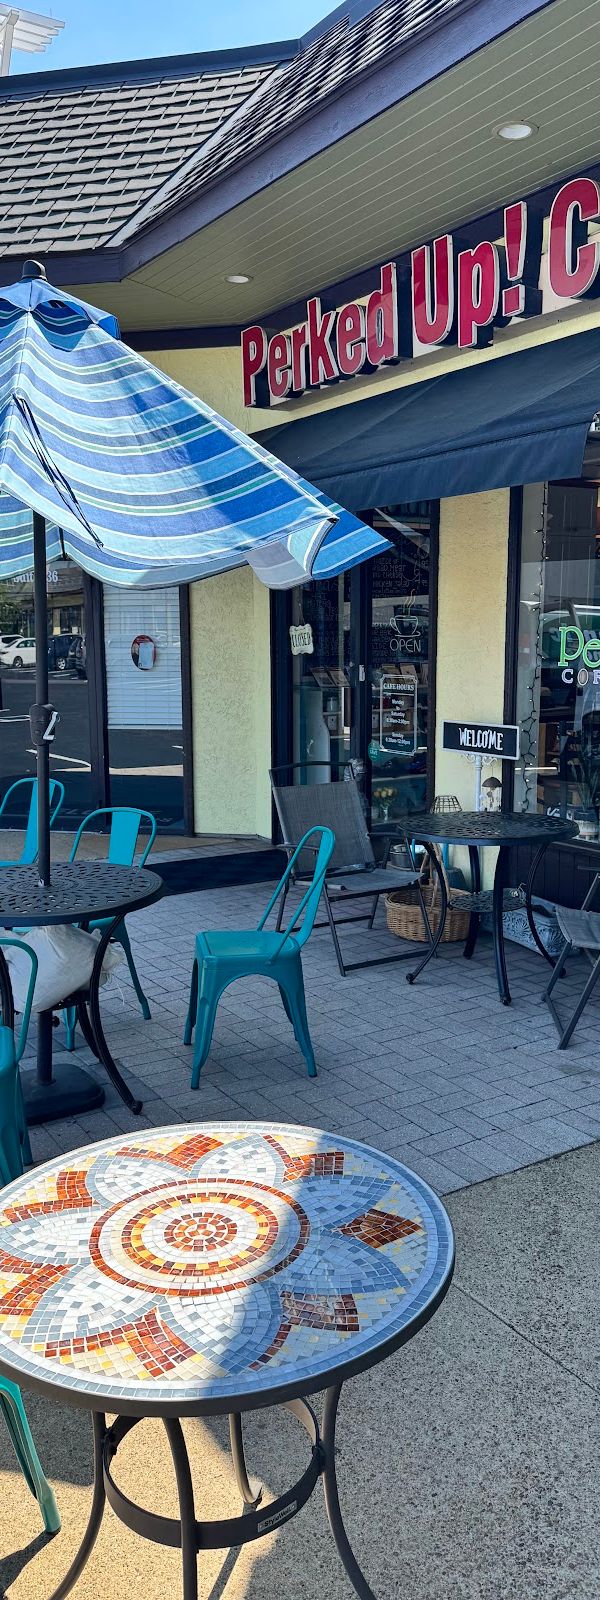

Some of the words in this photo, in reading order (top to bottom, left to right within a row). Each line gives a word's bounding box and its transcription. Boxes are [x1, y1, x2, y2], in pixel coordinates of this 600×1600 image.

[241, 261, 398, 407] Perked
[411, 201, 528, 348] Up!
[291, 632, 312, 648] CLOSED
[389, 638, 421, 653] OPEN
[396, 683, 415, 691] HOURS
[458, 727, 504, 751] WELCOME
